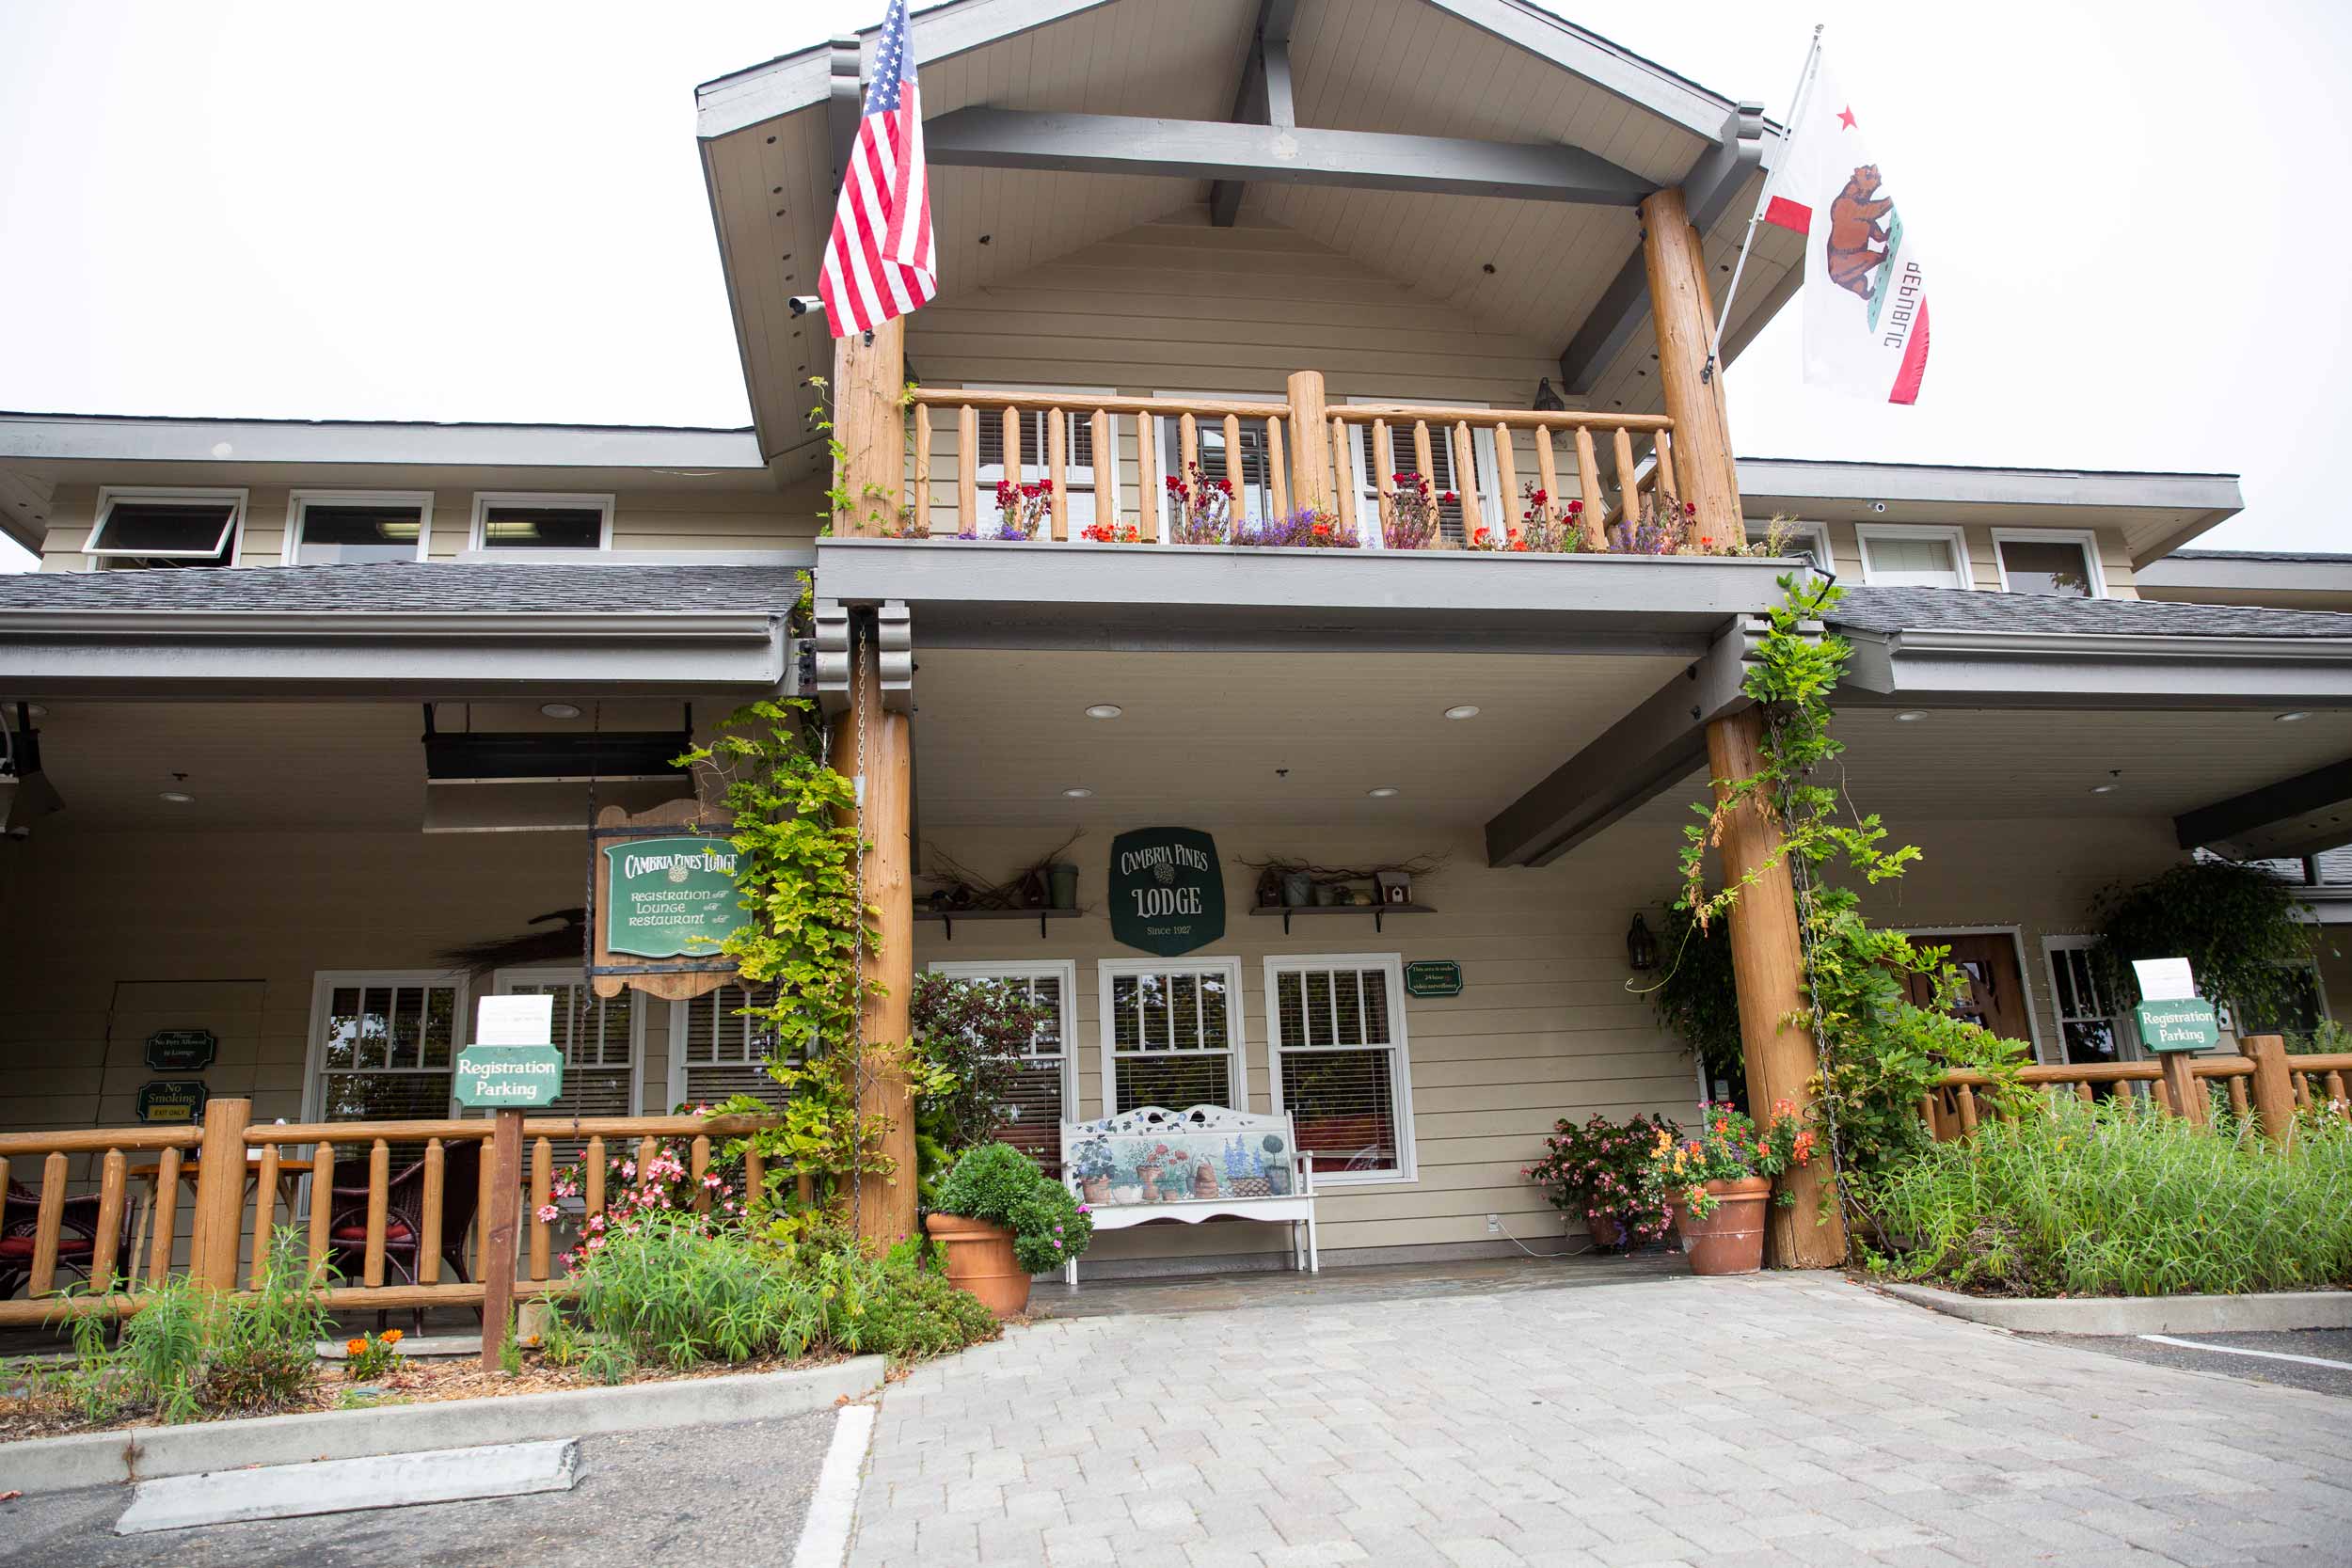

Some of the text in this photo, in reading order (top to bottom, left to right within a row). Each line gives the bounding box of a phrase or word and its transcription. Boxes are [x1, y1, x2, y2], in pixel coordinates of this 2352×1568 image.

[625, 853, 739, 879] CAMBRIA PINES LODGE
[1120, 844, 1209, 876] CAMBRIA PINES
[1131, 887, 1202, 919] LODGE
[1146, 926, 1192, 935] Since 1927
[2142, 1010, 2215, 1028] Registration
[2159, 1027, 2205, 1043] Parking
[458, 1059, 556, 1080] Registration
[165, 1083, 182, 1093] No
[475, 1081, 537, 1100] Parking
[149, 1092, 197, 1105] Smoking
